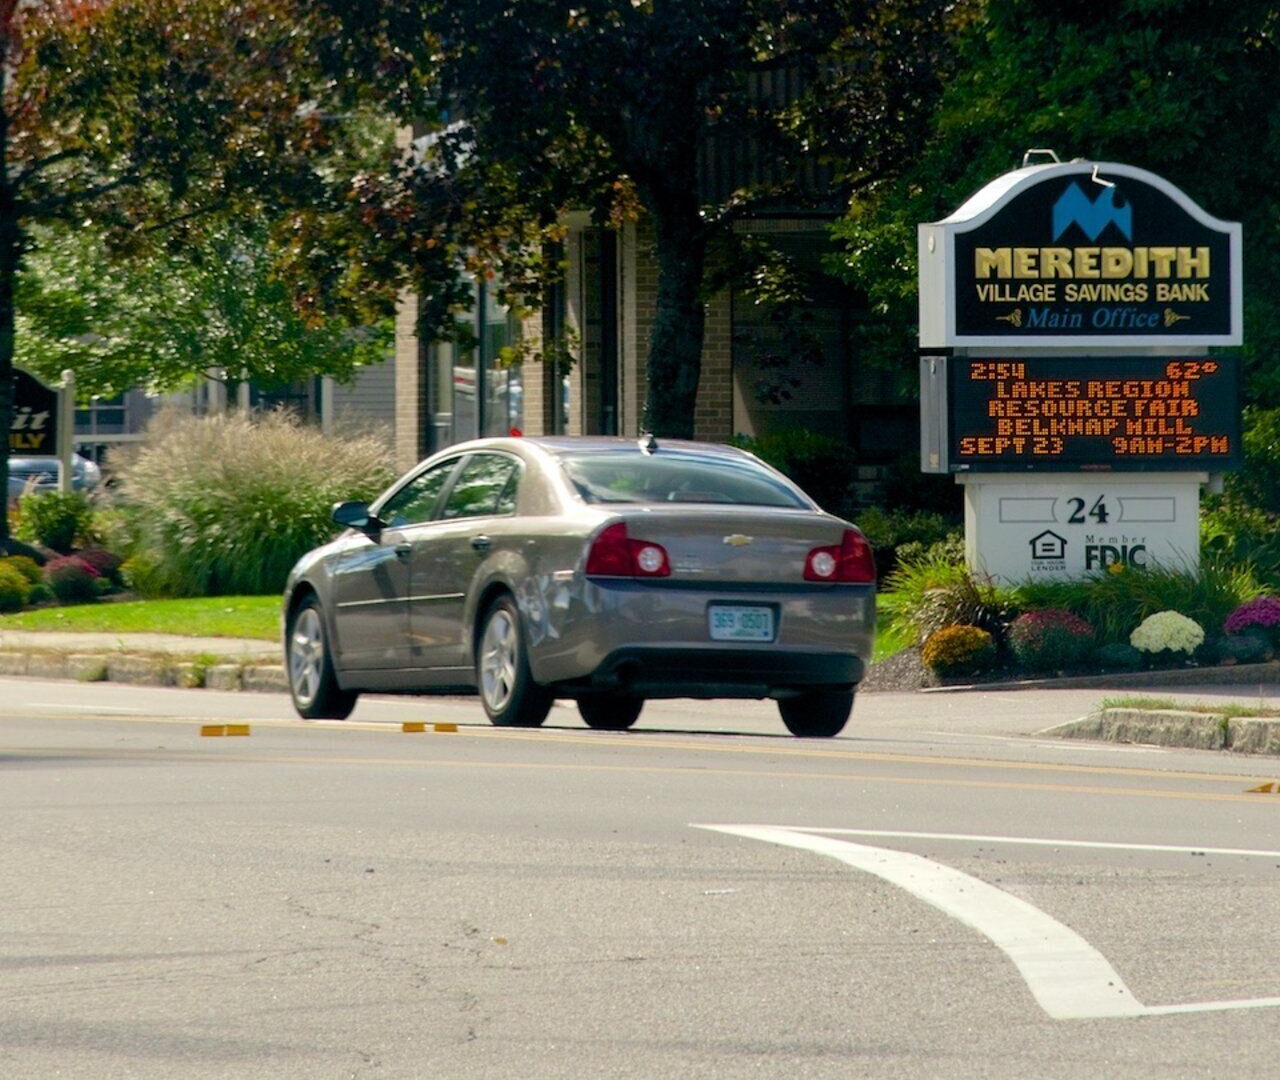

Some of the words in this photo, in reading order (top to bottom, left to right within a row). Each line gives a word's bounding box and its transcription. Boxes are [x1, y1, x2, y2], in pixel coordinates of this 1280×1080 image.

[974, 246, 1211, 279] MEREDITH
[976, 283, 1056, 302] VILLAGE
[1064, 283, 1148, 302] SAVINGS
[1156, 283, 1210, 302] BANK
[1026, 308, 1083, 328] Main
[1092, 307, 1160, 328] Office
[971, 363, 1025, 380] 2:54
[997, 381, 1080, 398] LAKES
[1087, 381, 1189, 398] REGION
[988, 400, 1127, 417] RESOURCE
[1134, 400, 1198, 417] FAIR
[998, 419, 1119, 435] BELKNAP
[1126, 419, 1192, 435] MILL
[960, 438, 1025, 454] SEPT
[1033, 438, 1063, 454] 23
[1112, 437, 1228, 454] 9AM-2PM
[1066, 494, 1110, 524] 24
[1085, 534, 1146, 544] Member
[1085, 545, 1146, 570] FDIC
